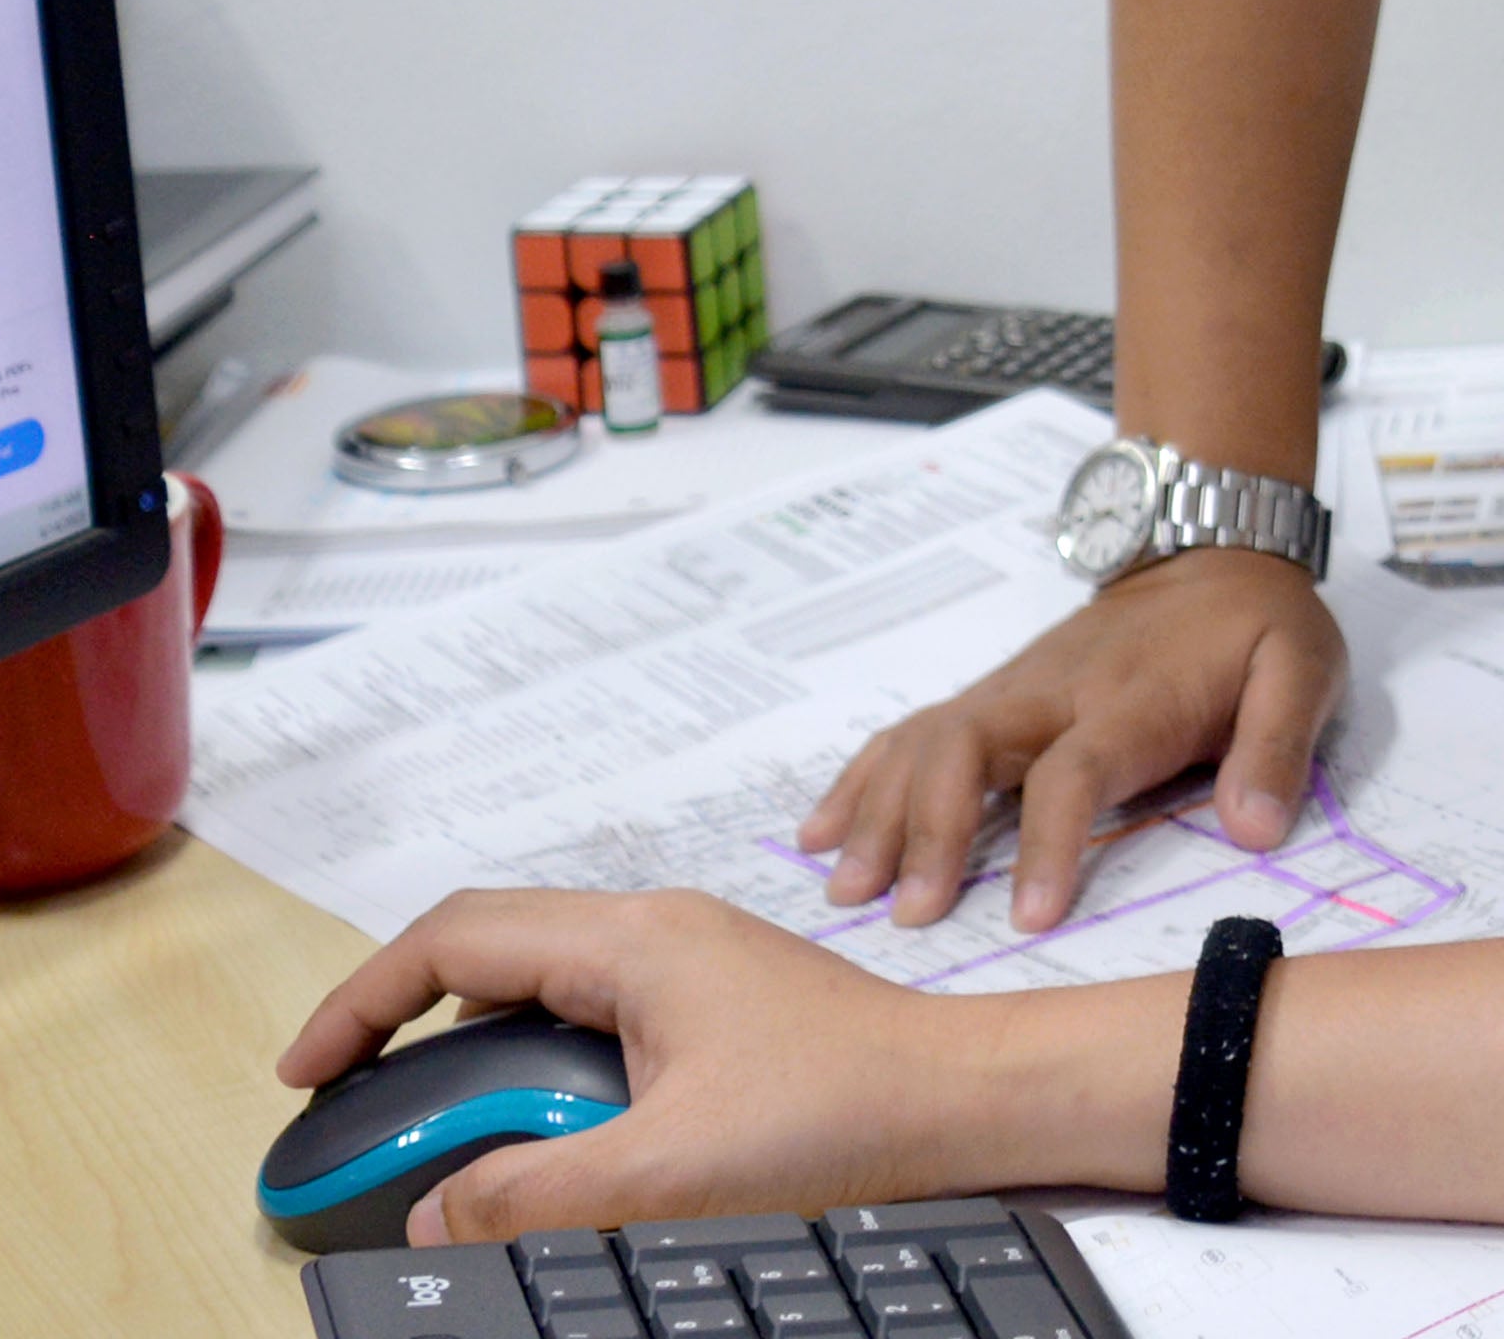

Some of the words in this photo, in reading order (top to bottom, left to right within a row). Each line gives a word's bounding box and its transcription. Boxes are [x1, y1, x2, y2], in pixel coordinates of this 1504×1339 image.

[858, 1209, 879, 1230] Enter
[1003, 1247, 1023, 1260] Del
[863, 1264, 885, 1273] 3
[759, 1271, 782, 1279] 6
[655, 1279, 678, 1288] 9
[398, 1275, 450, 1307] logi
[885, 1304, 908, 1313] 2
[779, 1312, 803, 1321] 5
[674, 1321, 697, 1329] 8
